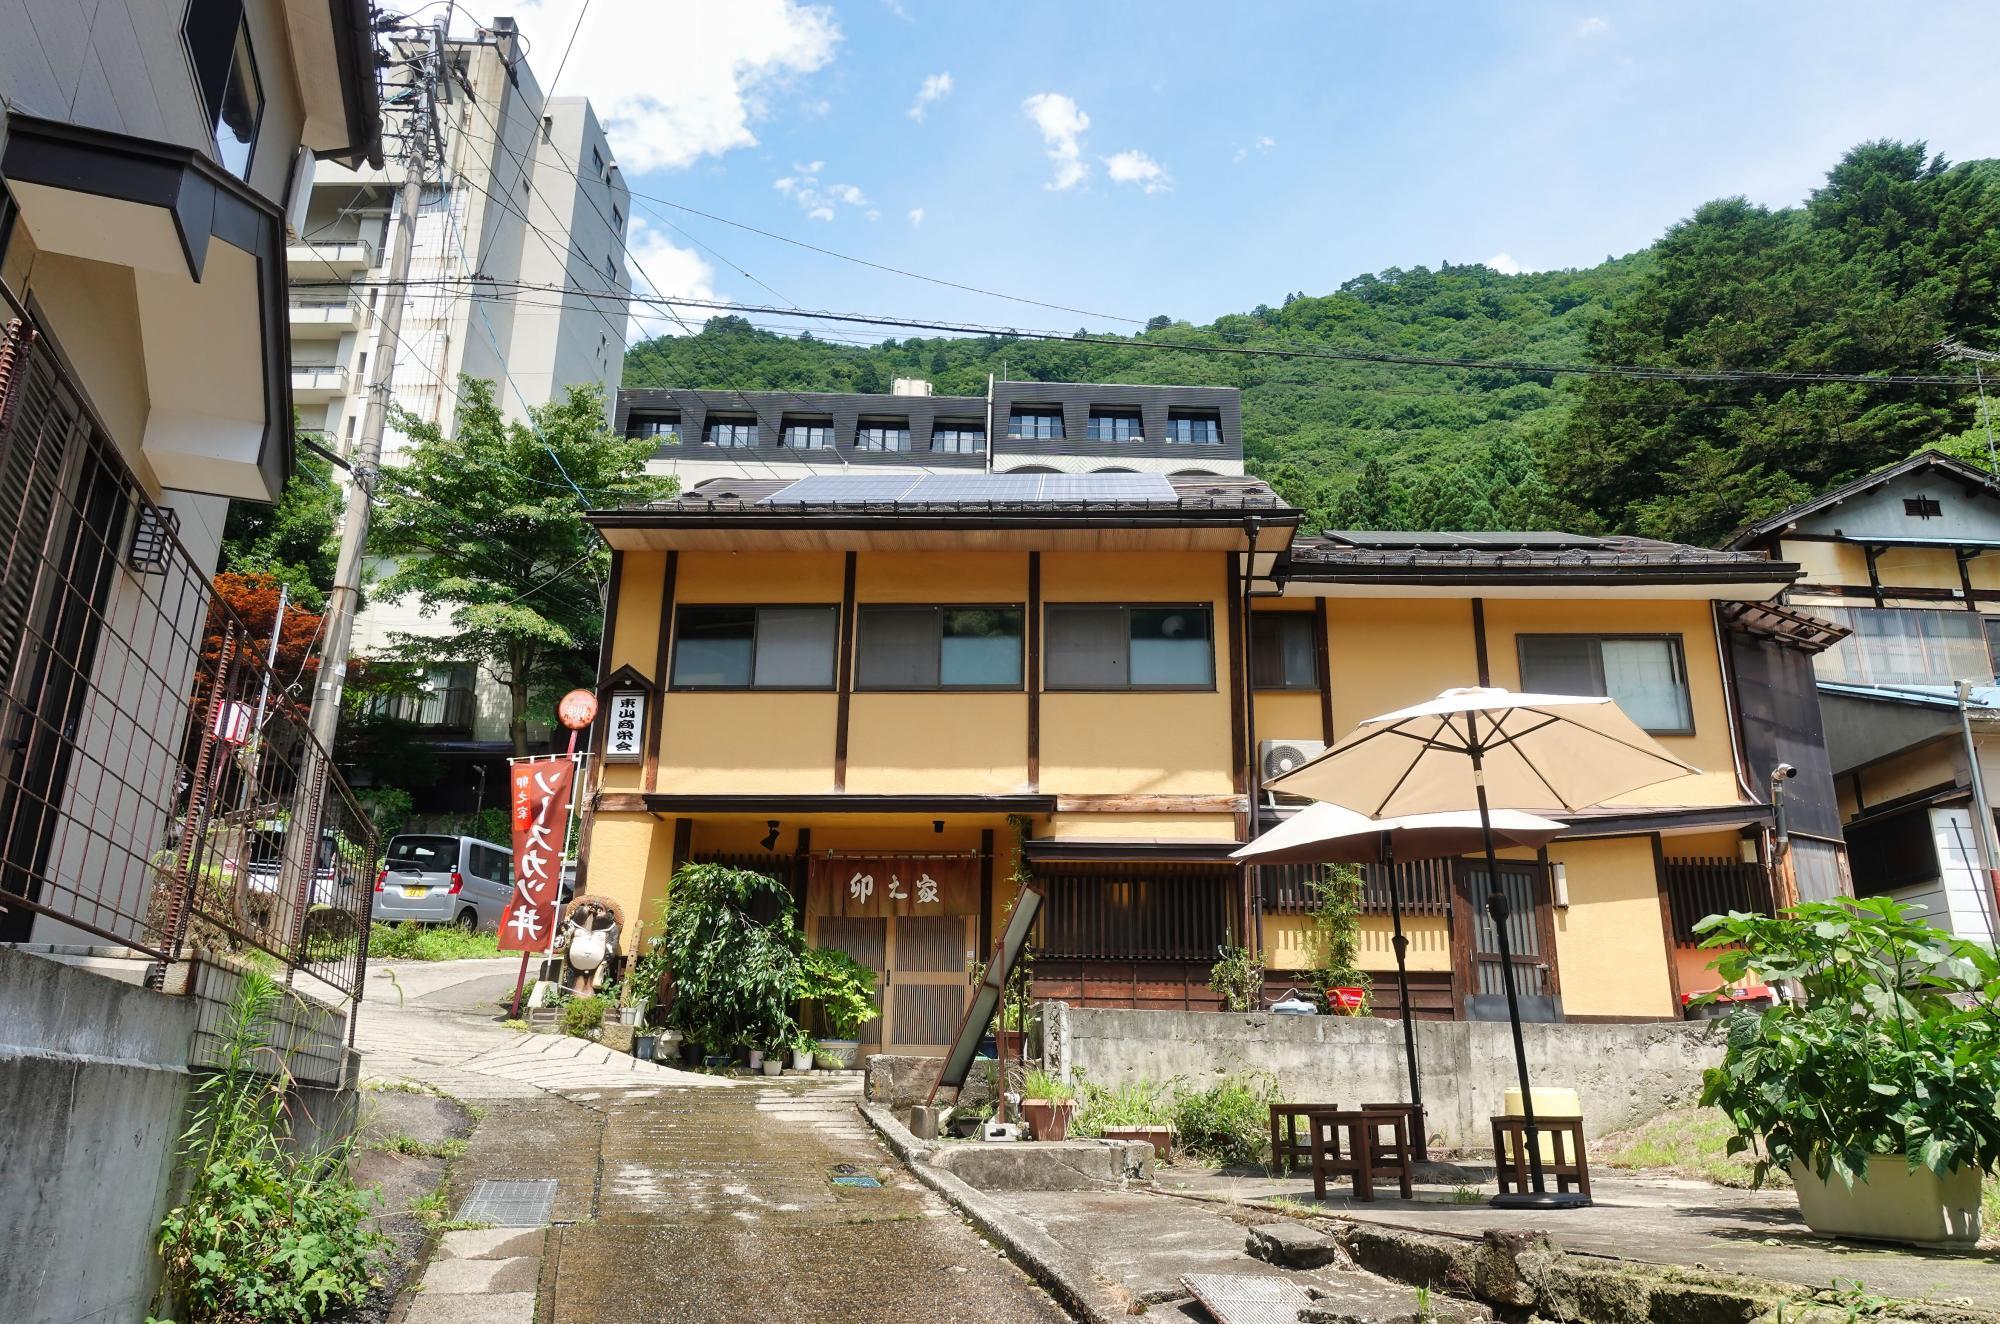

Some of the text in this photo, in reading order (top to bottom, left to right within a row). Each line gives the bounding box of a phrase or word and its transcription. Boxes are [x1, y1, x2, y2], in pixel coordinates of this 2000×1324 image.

[615, 698, 637, 752] 東山商栄会
